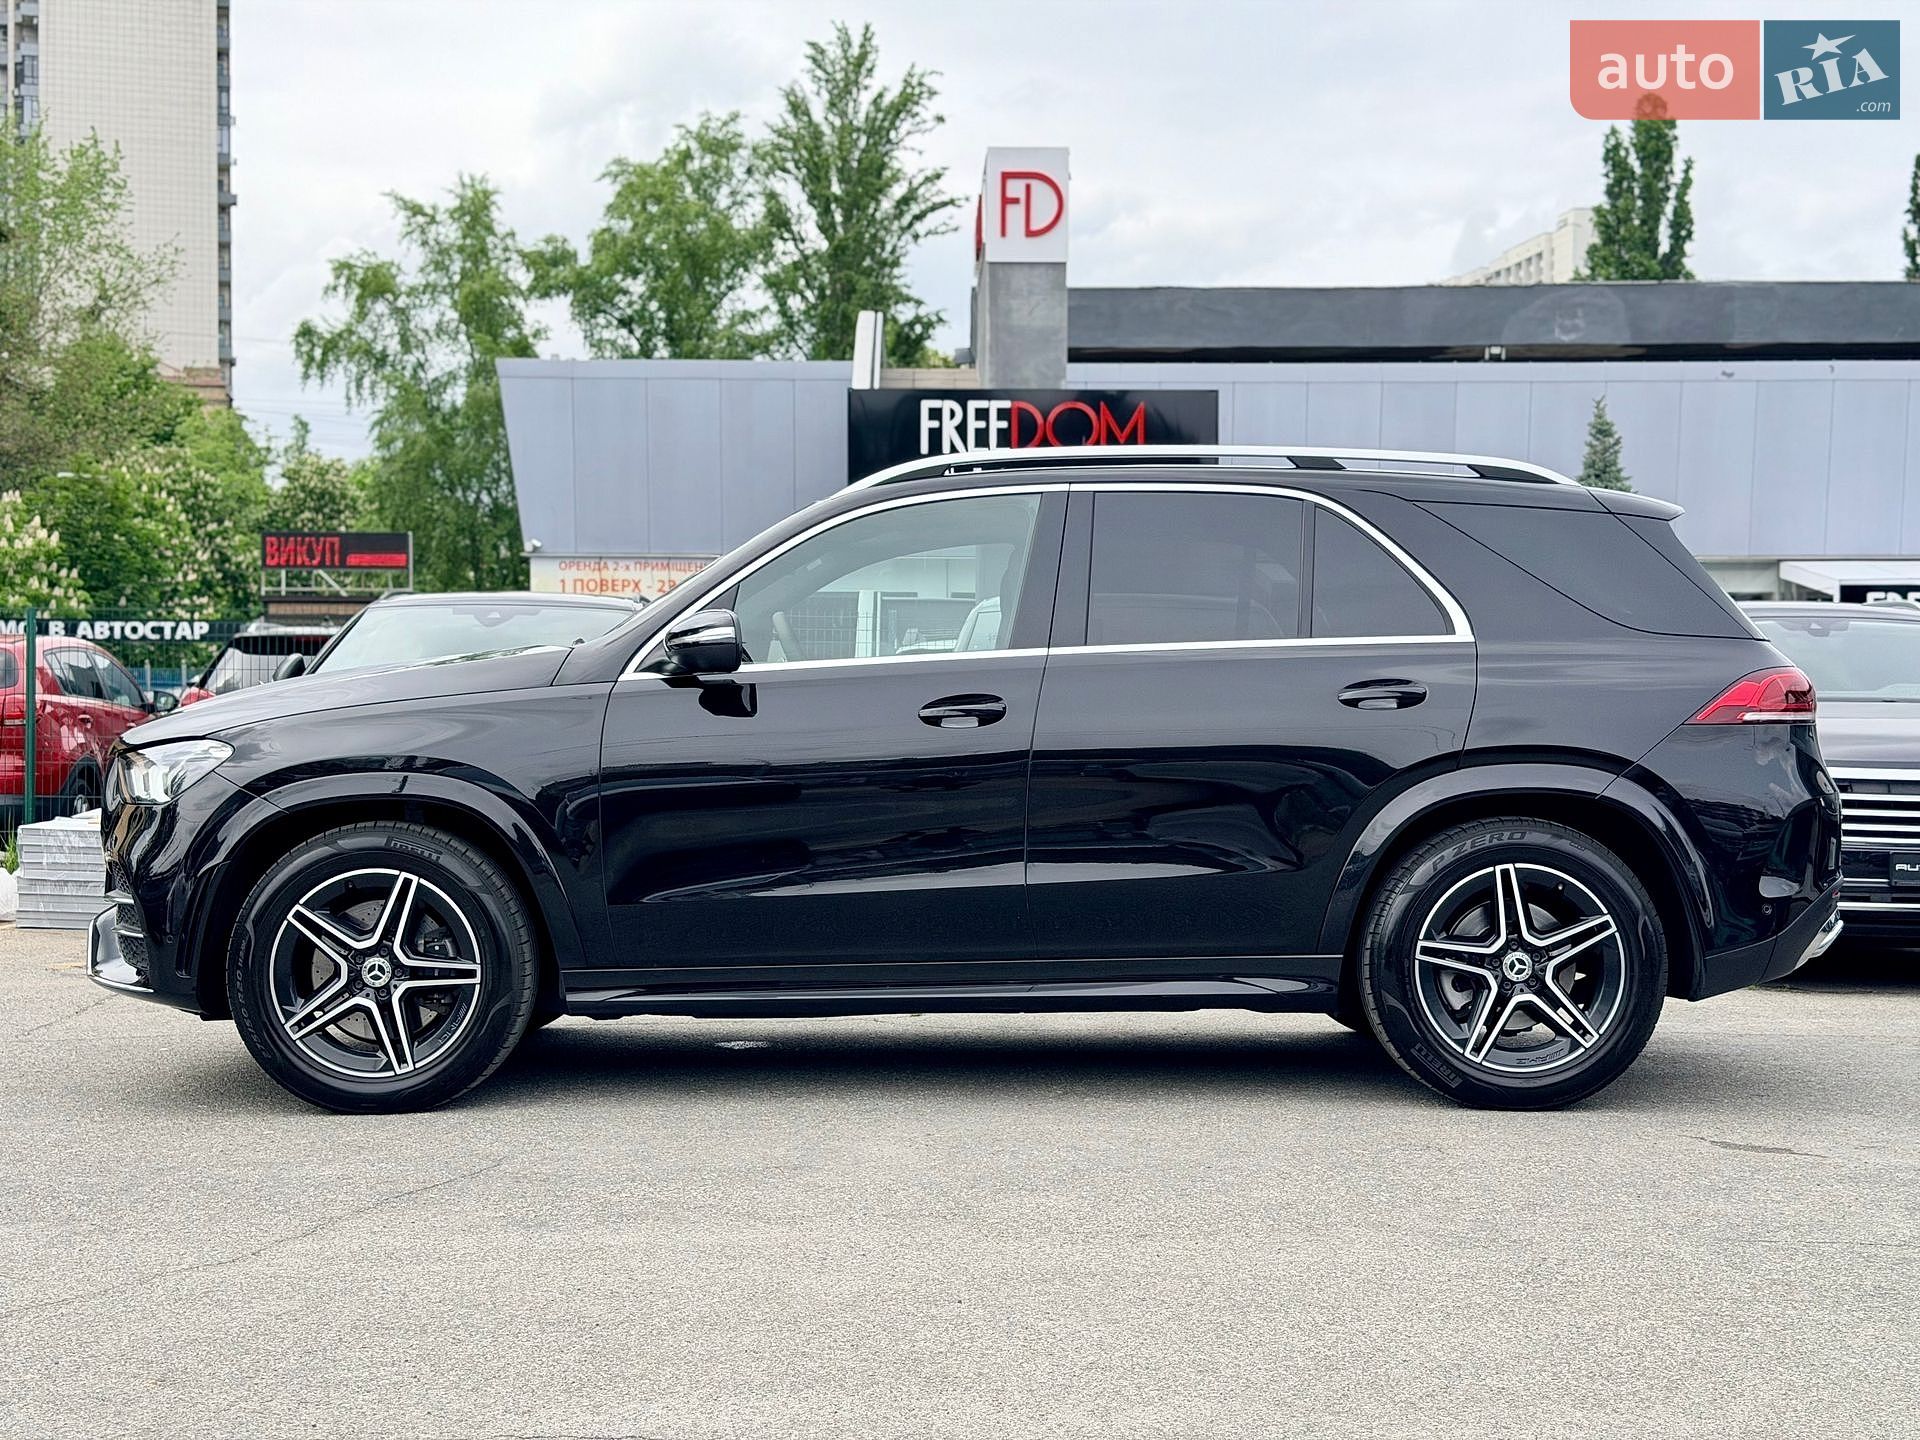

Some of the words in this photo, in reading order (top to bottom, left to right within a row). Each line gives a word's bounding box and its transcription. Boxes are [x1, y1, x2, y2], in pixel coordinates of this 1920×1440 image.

[1000, 171, 1064, 238] FD
[920, 399, 1145, 454] FREEDOM
[265, 536, 341, 566] ВИКУП
[559, 560, 609, 573] ОРЕНДА
[560, 579, 566, 593] 1
[574, 579, 642, 593] ПОВЕРХ
[49, 620, 65, 637] В
[77, 620, 210, 640] АВТОСТАР
[1452, 831, 1528, 858] ZERO
[1895, 863, 1920, 871] AU
